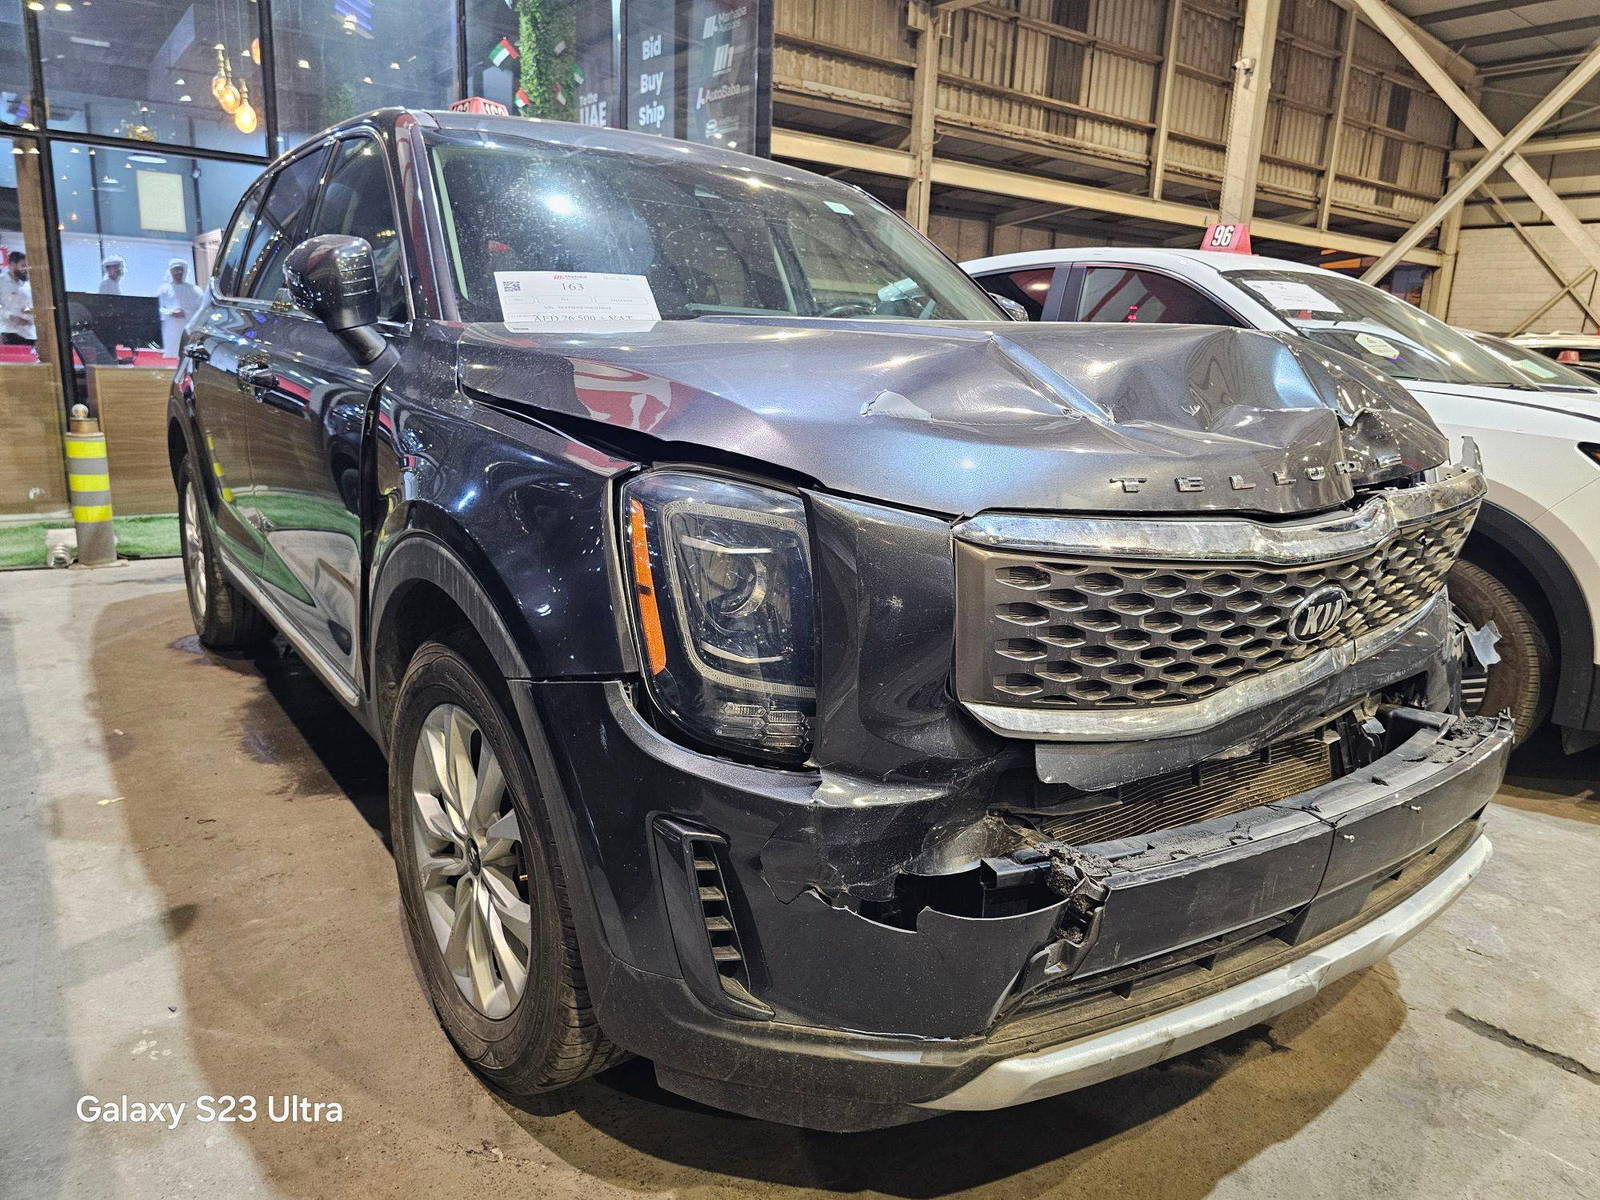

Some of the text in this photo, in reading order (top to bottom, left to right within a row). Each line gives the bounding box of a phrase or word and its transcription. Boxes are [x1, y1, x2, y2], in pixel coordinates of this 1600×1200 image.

[642, 34, 662, 61] Bid
[640, 72, 664, 96] Buy
[580, 101, 607, 127] UAE
[1211, 224, 1236, 247] 96
[562, 282, 585, 291] 163
[1299, 598, 1343, 636] KIA
